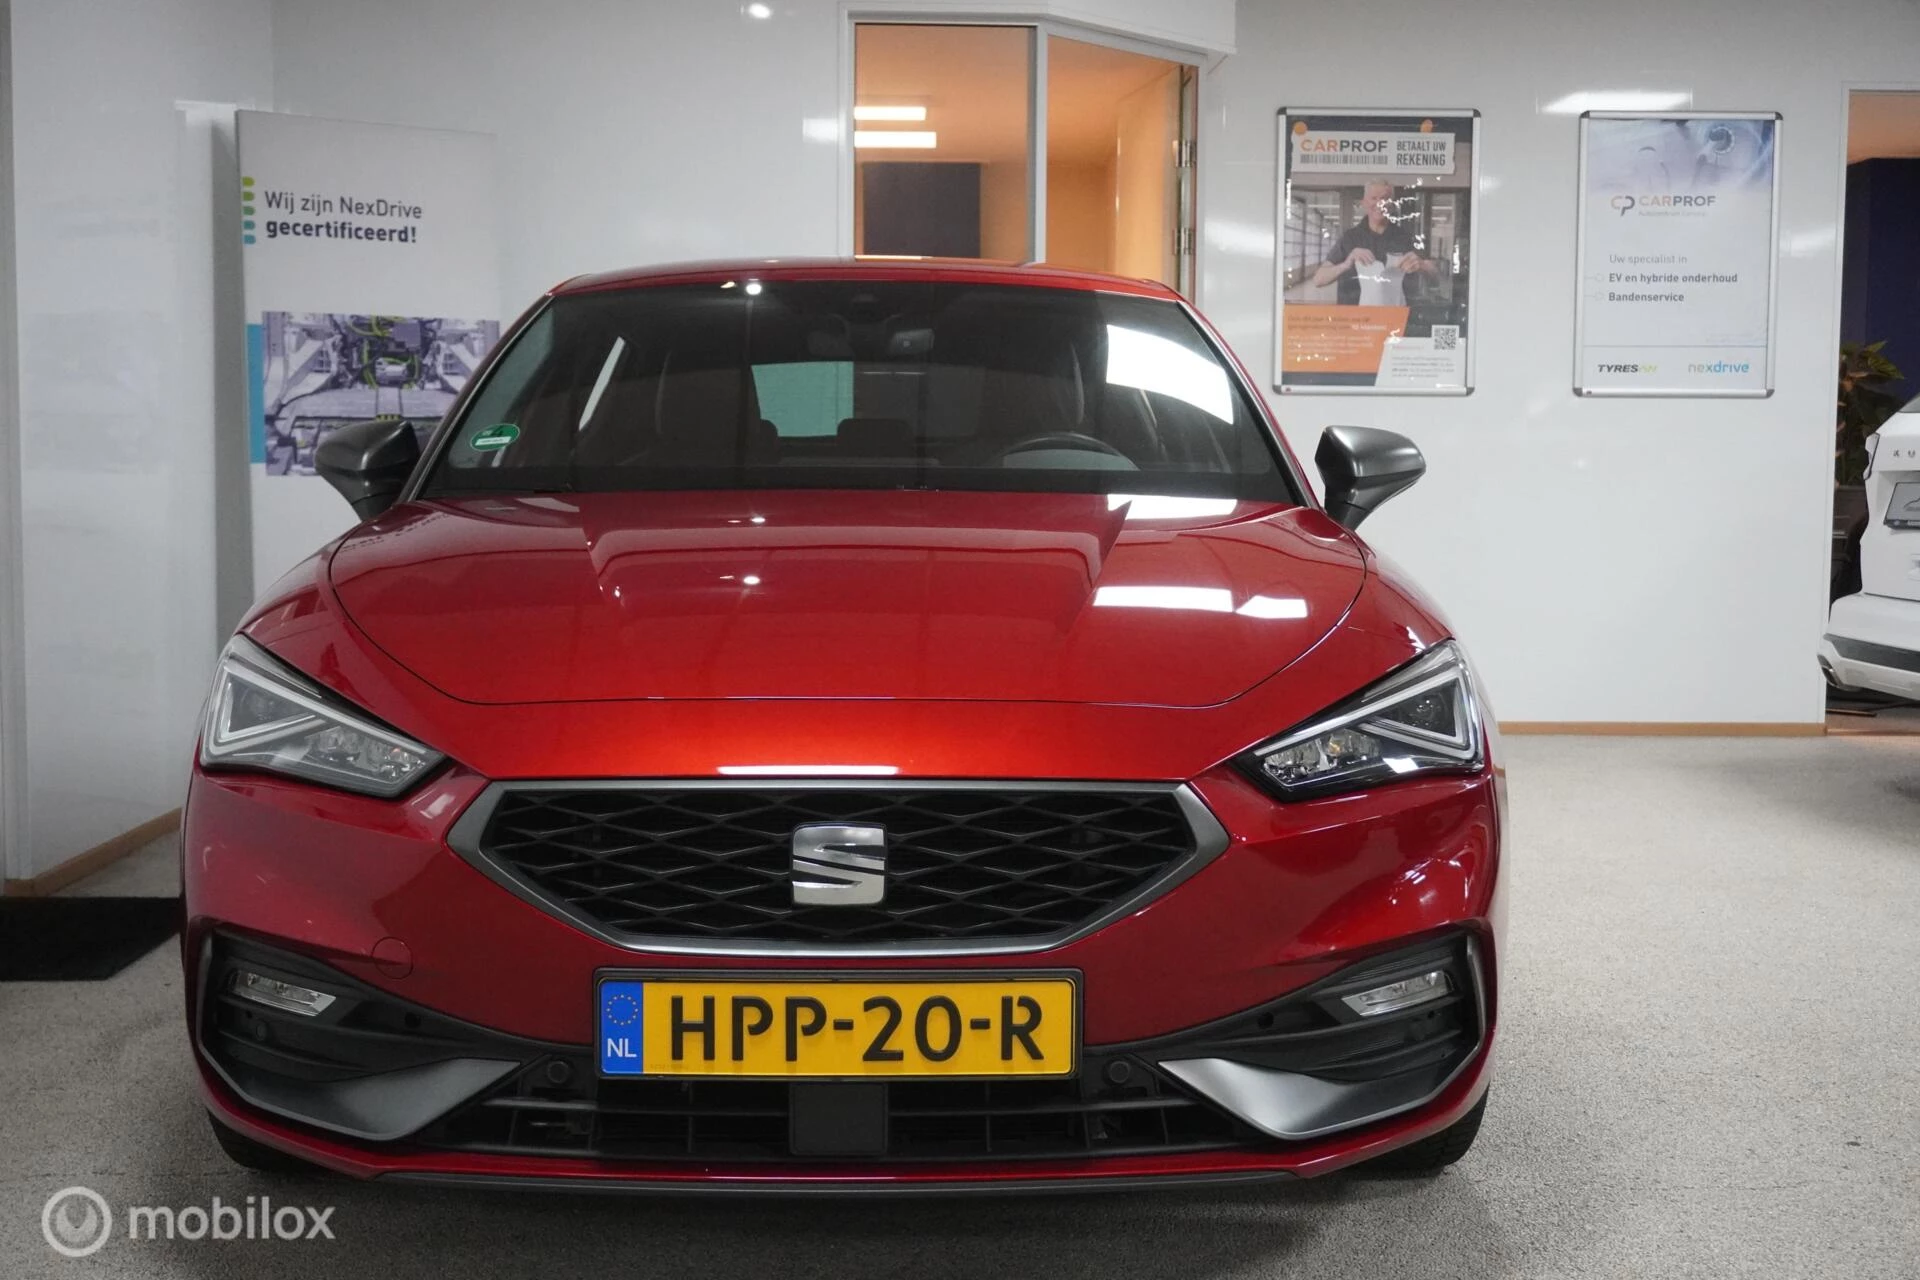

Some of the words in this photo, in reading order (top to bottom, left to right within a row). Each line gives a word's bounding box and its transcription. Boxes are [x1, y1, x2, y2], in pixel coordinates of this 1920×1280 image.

[1300, 139, 1389, 153] CARPROF
[1396, 140, 1430, 151] BETAALT
[1432, 141, 1446, 151] UW
[1396, 154, 1446, 166] REKENING
[265, 191, 295, 214] Wij
[300, 194, 333, 217] zijn
[339, 197, 422, 220] NexDrive
[1638, 195, 1716, 207] CARPROF
[265, 219, 417, 244] gecertificeerd!
[1609, 254, 1625, 264] Uw
[1628, 254, 1675, 266] specialist
[1678, 255, 1687, 264] in
[1608, 273, 1622, 283] EV
[1625, 275, 1637, 283] en
[1640, 273, 1679, 285] hybride
[1681, 273, 1738, 283] onderhoud
[1608, 292, 1685, 302] Bandenservice
[1688, 360, 1750, 373] nexdrive
[669, 995, 1044, 1061] HPP-20-R
[606, 1038, 637, 1059] NL
